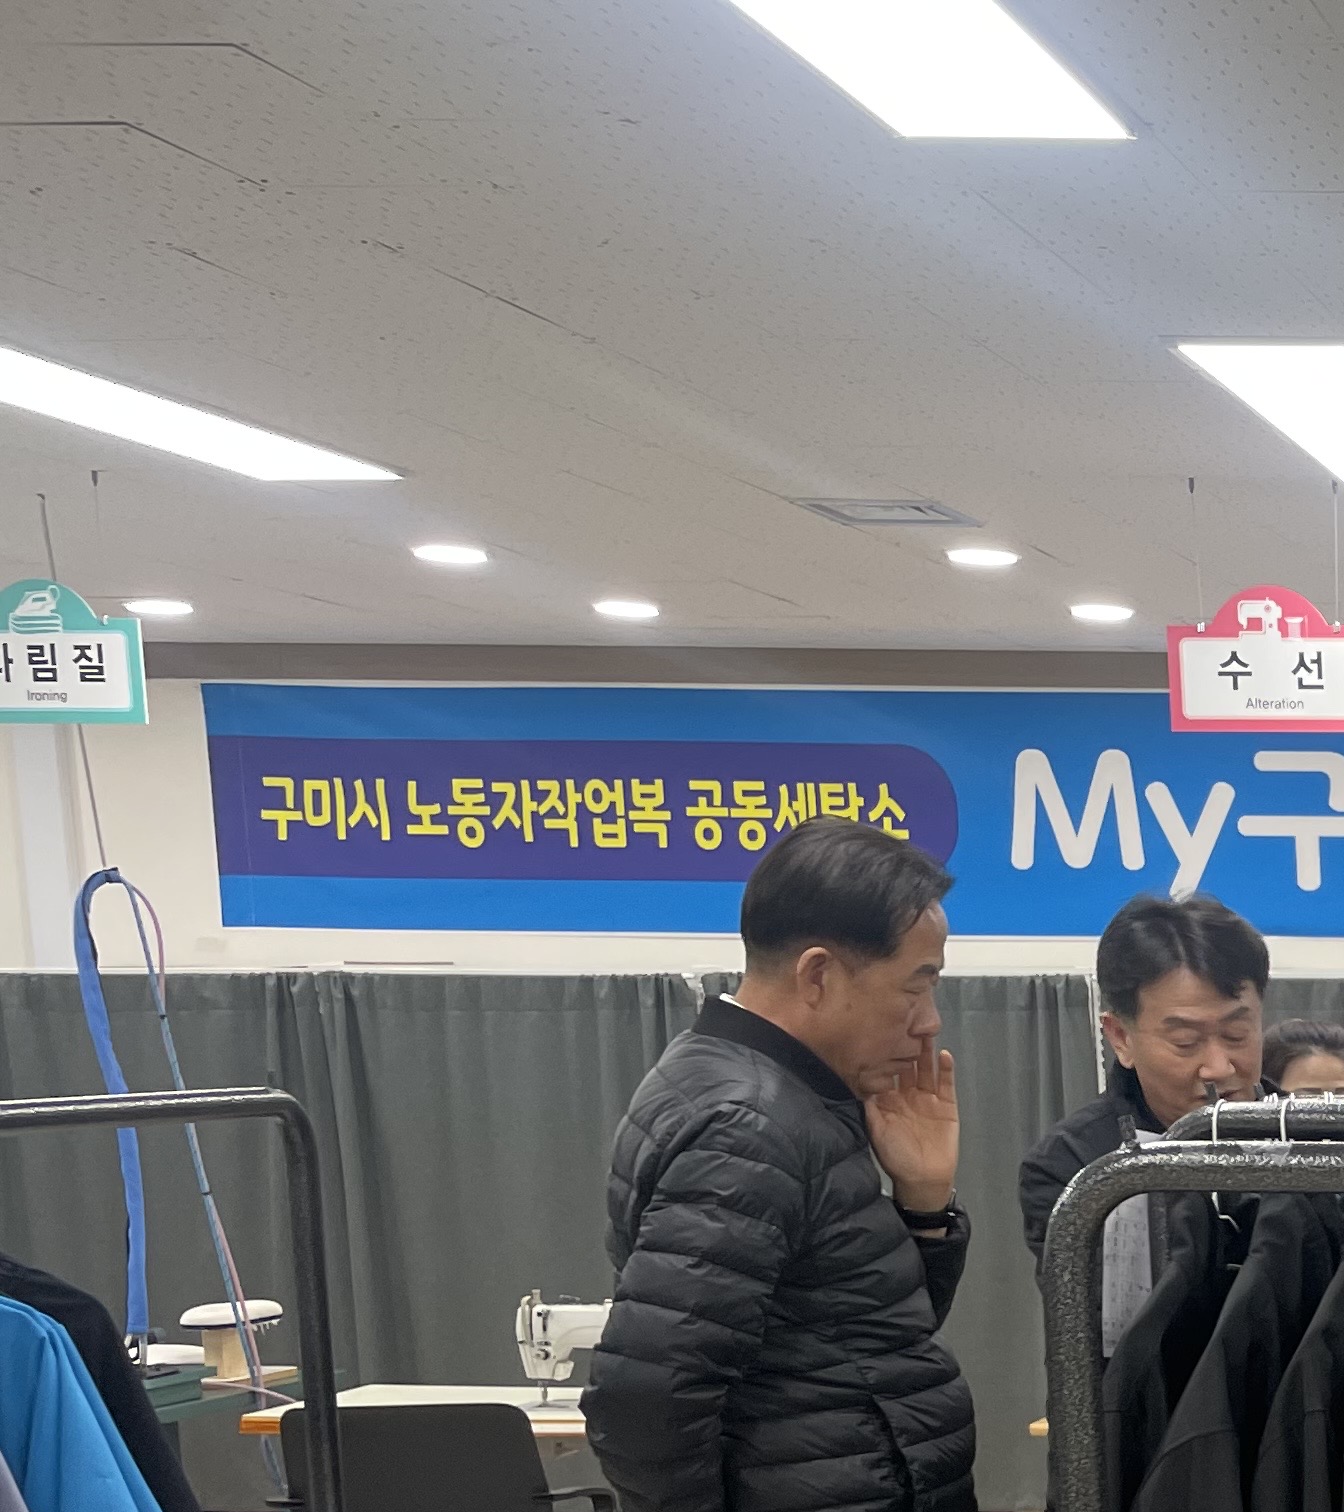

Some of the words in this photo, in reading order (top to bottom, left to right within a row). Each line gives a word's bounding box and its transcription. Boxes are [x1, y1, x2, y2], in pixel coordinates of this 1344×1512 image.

[27, 690, 68, 703] Ironing
[1246, 698, 1304, 710] Alteration
[261, 777, 391, 841] 구미시
[406, 778, 671, 849] 노동자작업복
